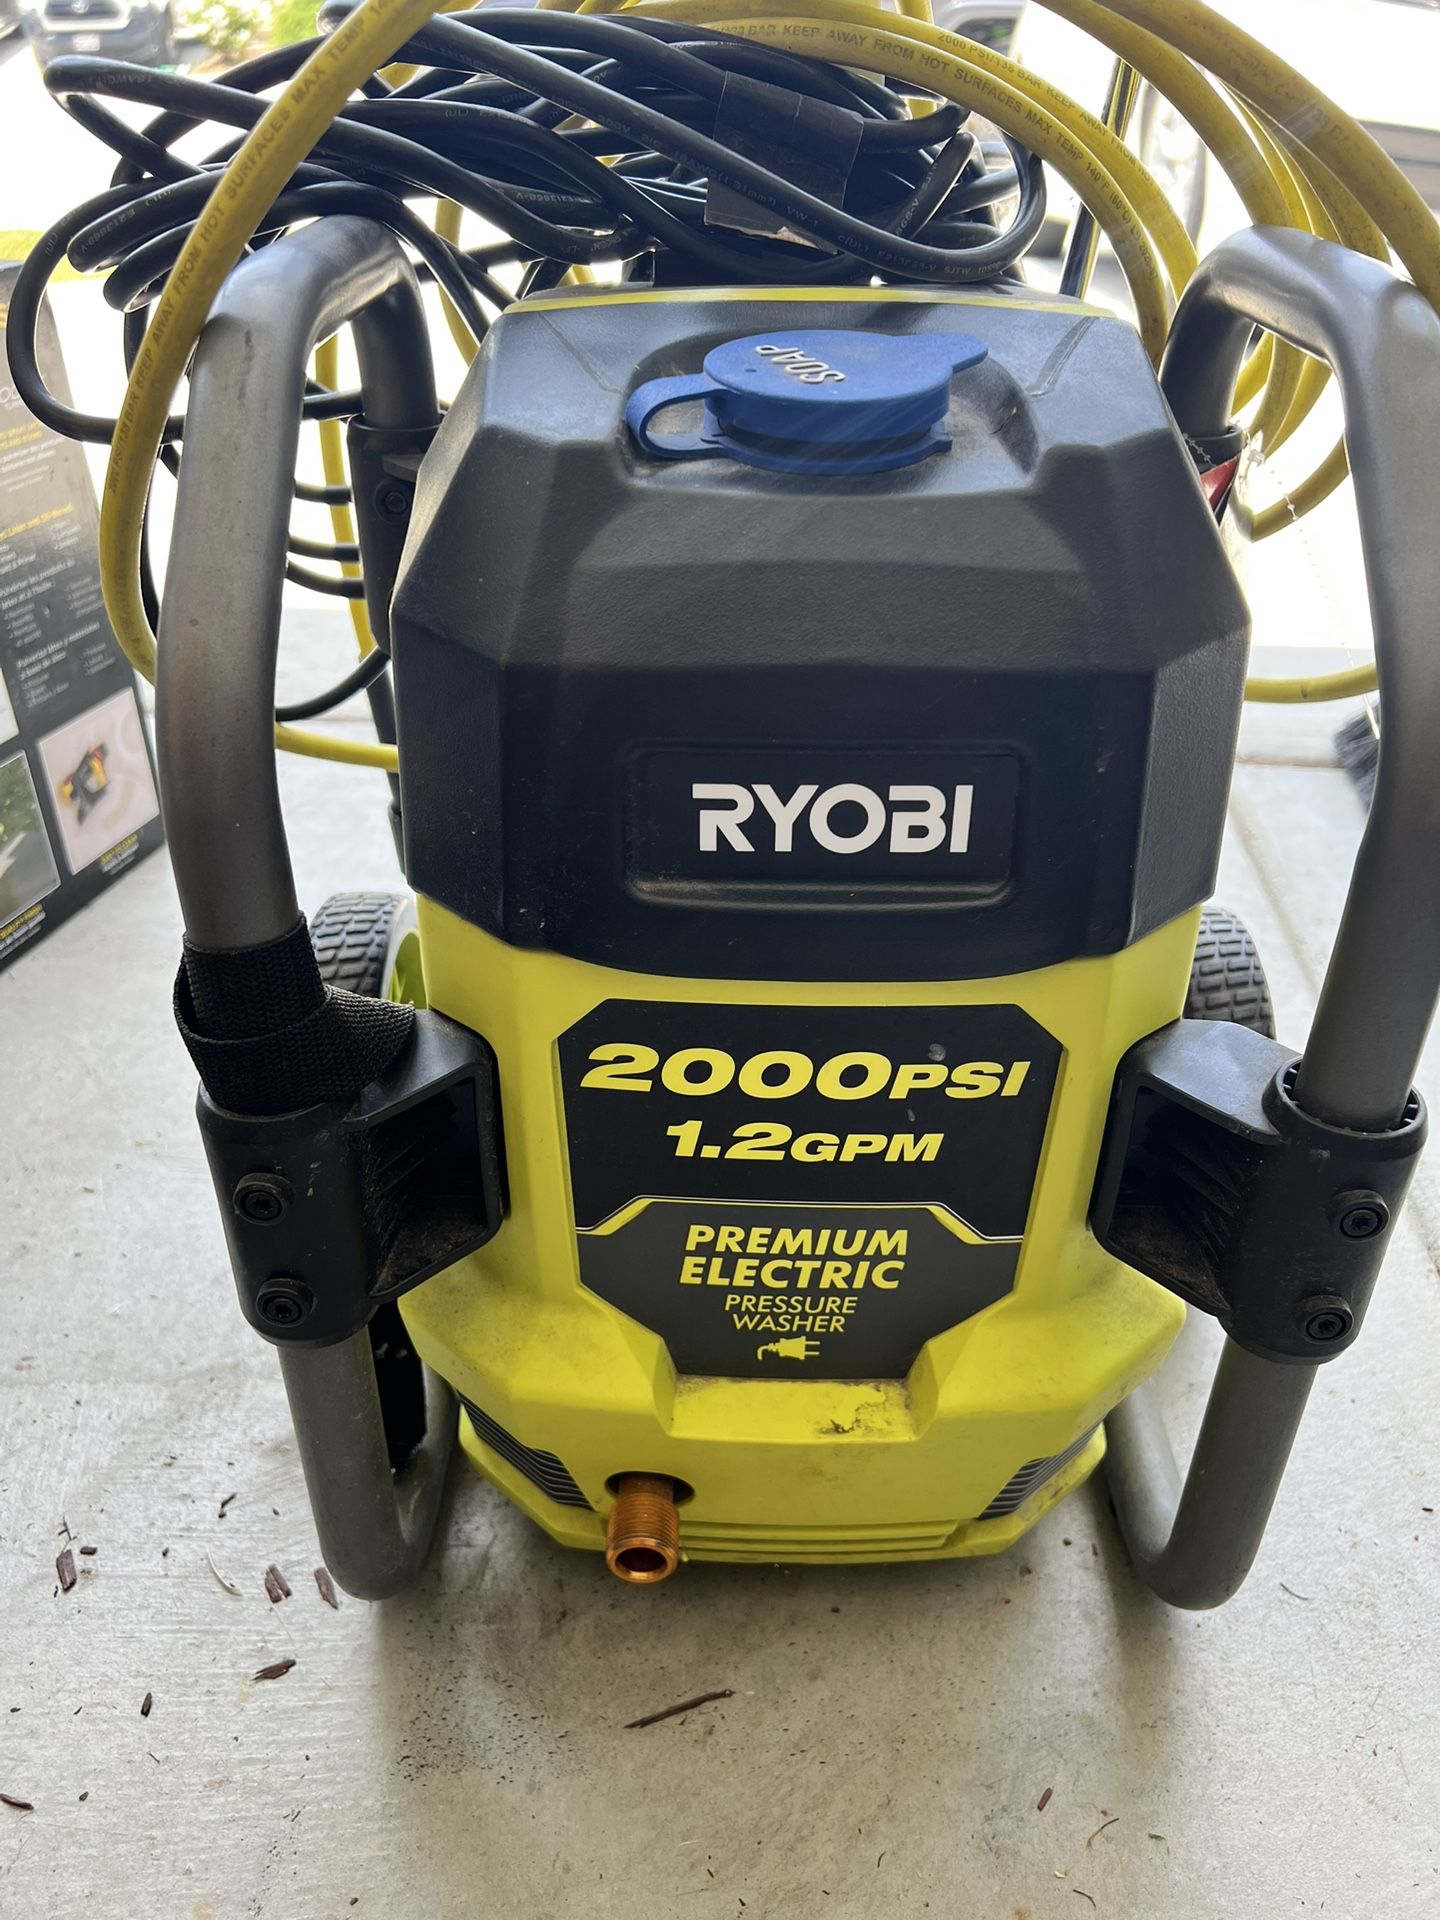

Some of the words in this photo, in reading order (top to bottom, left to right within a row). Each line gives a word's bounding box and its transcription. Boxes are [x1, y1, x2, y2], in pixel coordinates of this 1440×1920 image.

[783, 24, 820, 38] KEEP
[827, 29, 868, 48] AWAY
[873, 38, 915, 61] FROM
[920, 53, 950, 73] HOT
[953, 67, 1024, 113] SURFACES
[1024, 107, 1053, 136] MAX
[1055, 130, 1085, 162] TEMP
[938, 32, 967, 51] 2000
[1017, 66, 1043, 90] BAR
[1045, 84, 1077, 110] KEEP
[1078, 112, 1109, 137] AWAY
[151, 298, 176, 345] AWAY
[172, 245, 203, 296] FROM
[200, 205, 226, 244] HOT
[224, 108, 291, 200] SURFACES
[290, 65, 326, 105] MAX
[326, 17, 365, 61] TEMP
[755, 344, 846, 384] SOAP
[692, 783, 974, 854] RYOBI
[580, 1043, 1031, 1100] 2000PSI
[666, 1119, 945, 1162] 1.2GPM
[685, 1224, 909, 1256] PREMIUM
[679, 1256, 906, 1290] ELECTRIC
[725, 1294, 859, 1314] PRESSURE
[732, 1313, 846, 1333] WASHER
